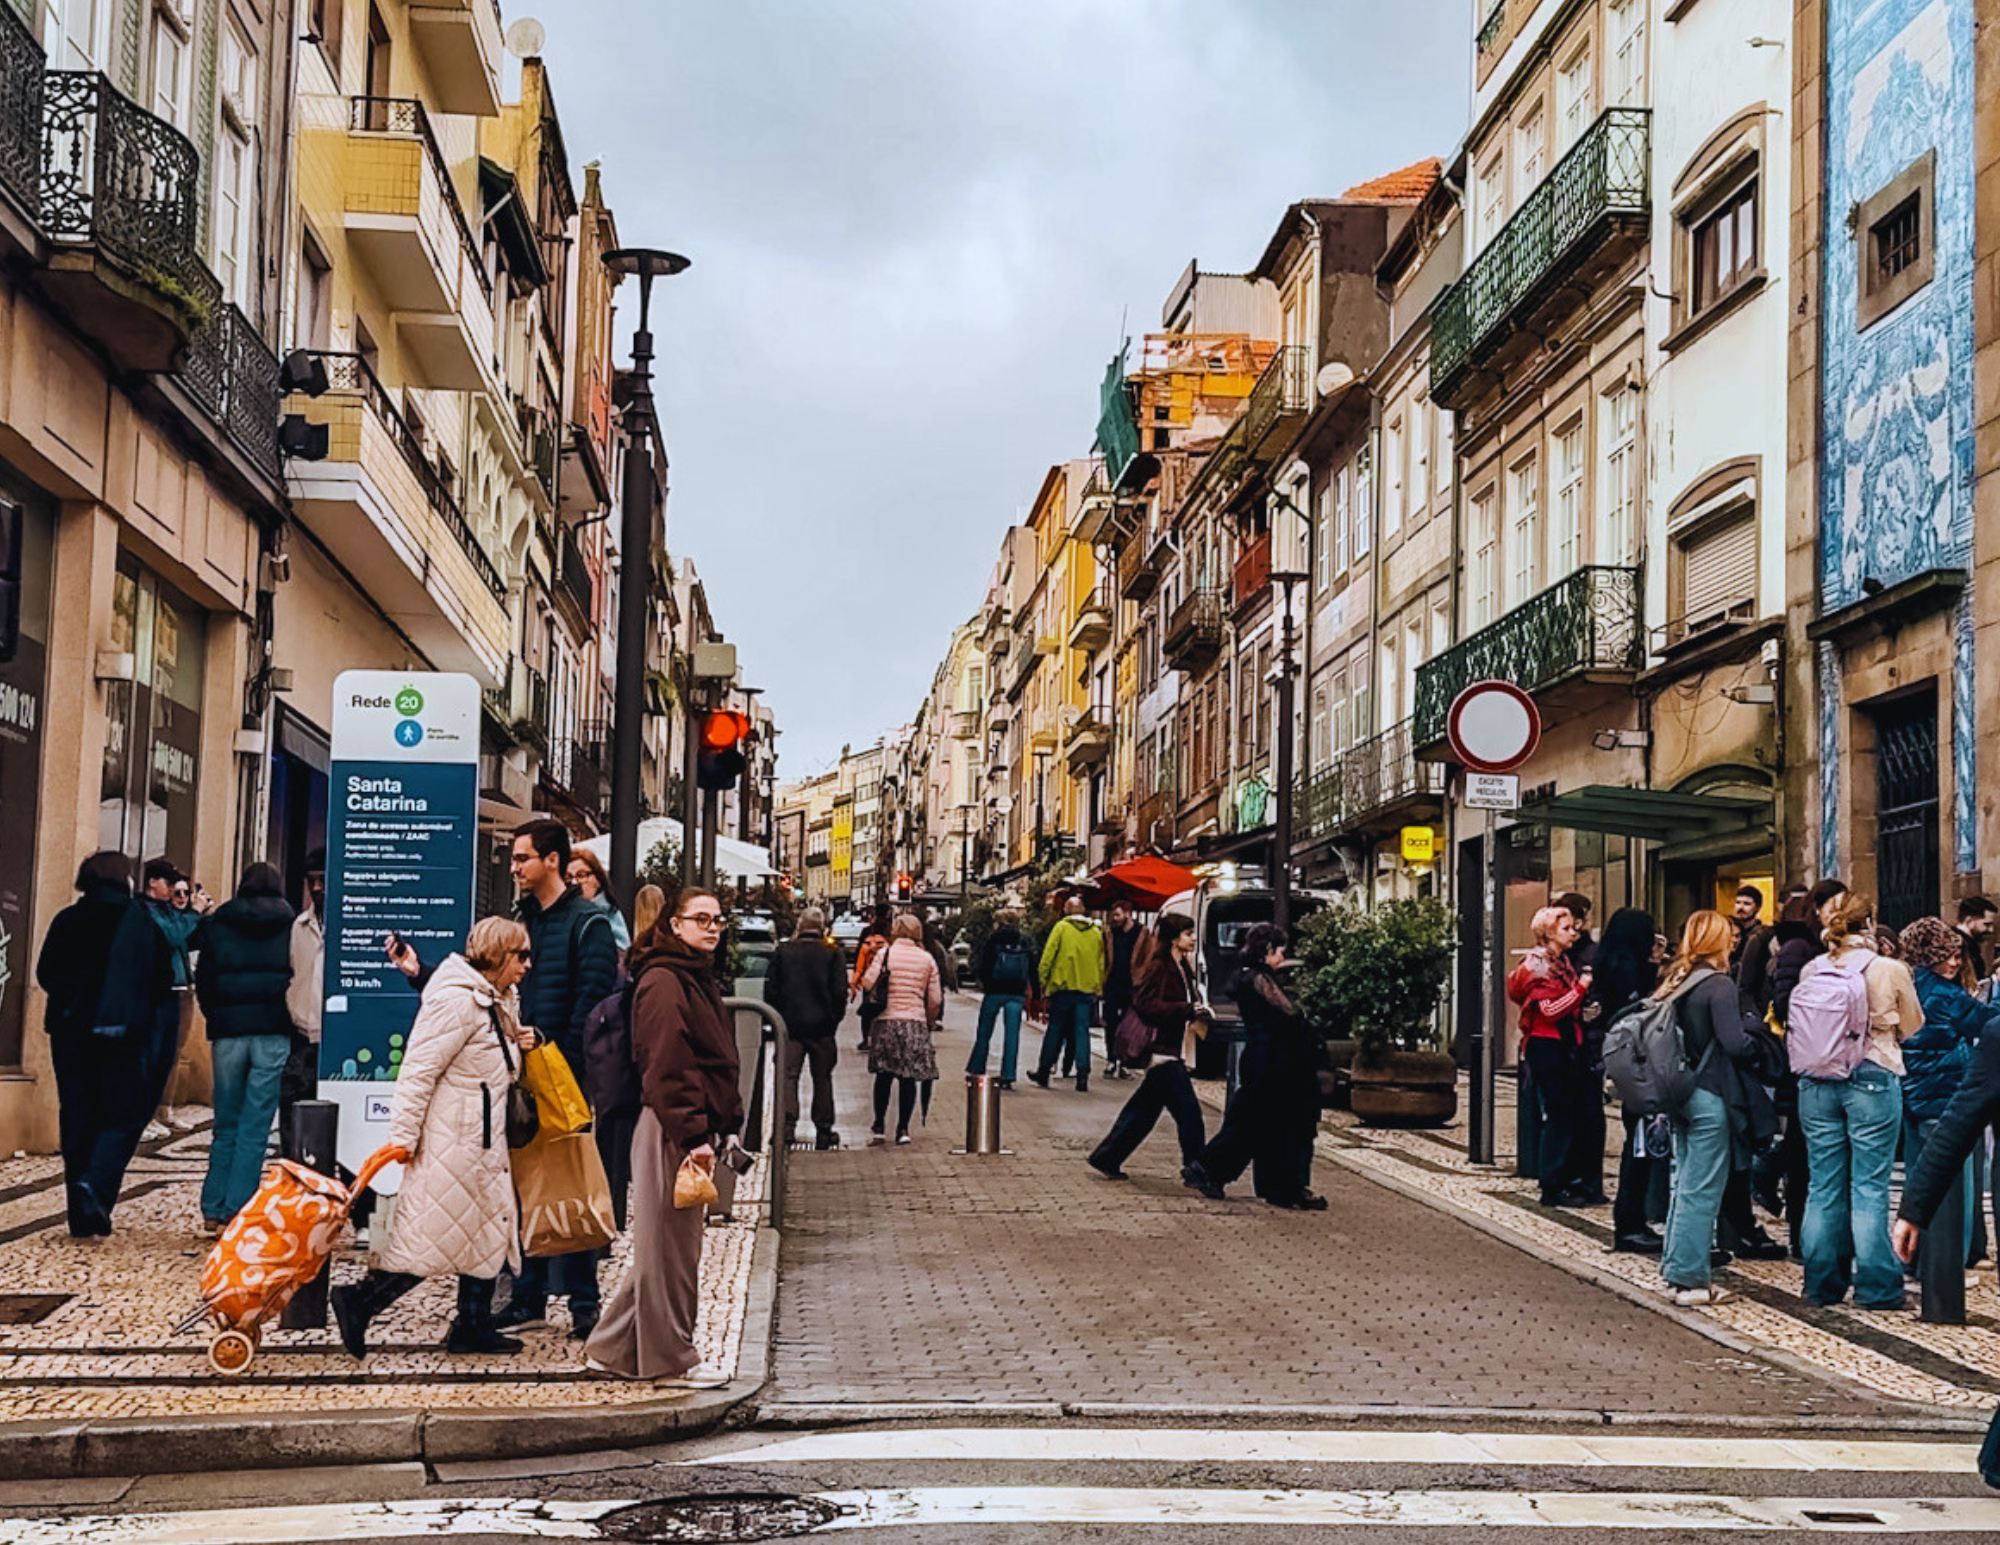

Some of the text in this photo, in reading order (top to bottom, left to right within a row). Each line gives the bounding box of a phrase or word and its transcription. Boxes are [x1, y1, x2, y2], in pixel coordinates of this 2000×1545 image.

[352, 694, 419, 710] Rede 20
[347, 775, 402, 793] Santa
[346, 793, 428, 811] Catarina
[340, 977, 382, 989] 10 km/h
[373, 1102, 390, 1114] Po
